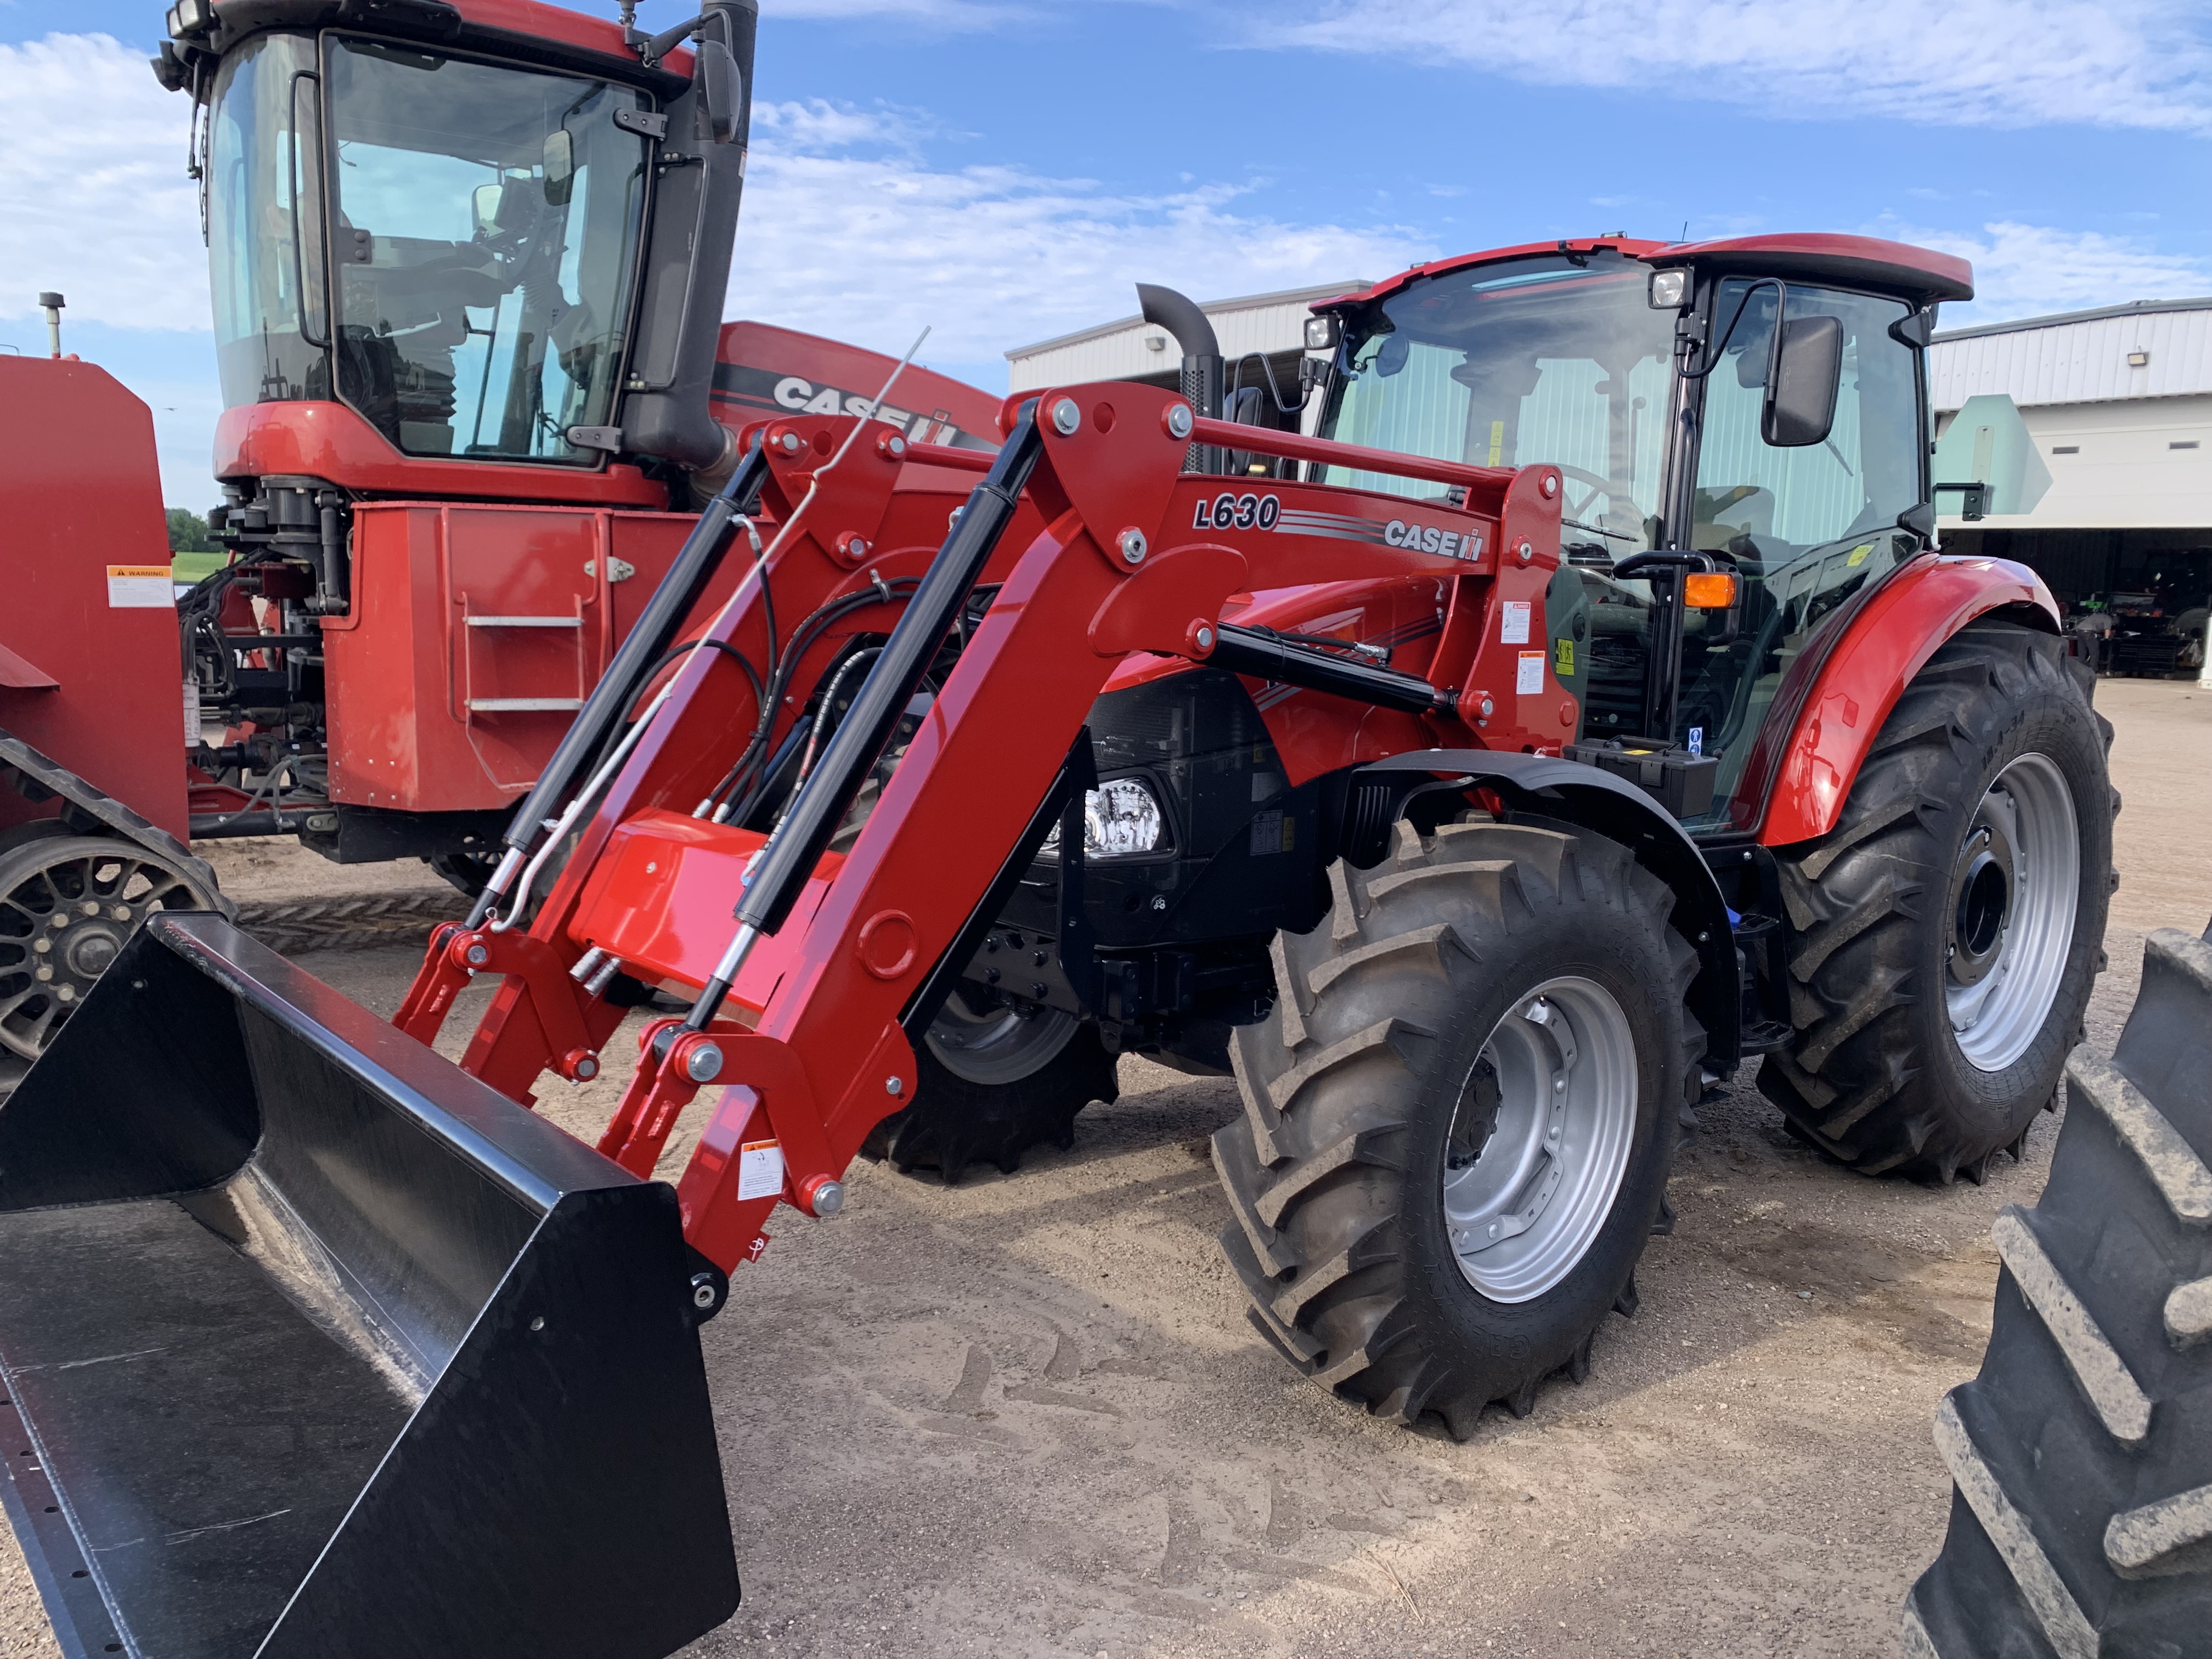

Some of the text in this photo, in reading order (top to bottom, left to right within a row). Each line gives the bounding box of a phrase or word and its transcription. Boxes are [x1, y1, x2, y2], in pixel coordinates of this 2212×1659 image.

[774, 377, 911, 430] CASE
[1192, 492, 1280, 530] L630
[1385, 520, 1459, 557] CASE
